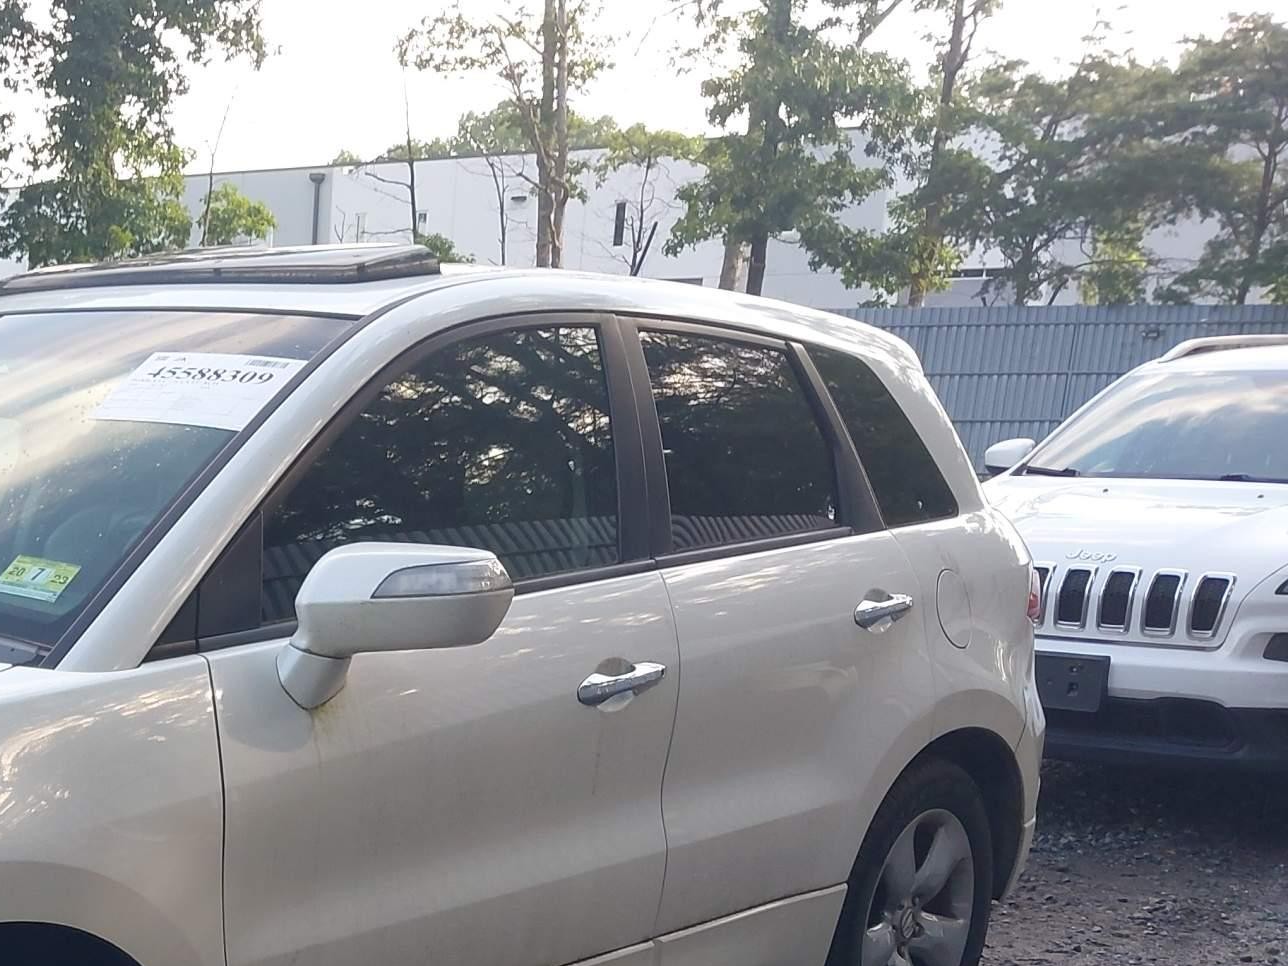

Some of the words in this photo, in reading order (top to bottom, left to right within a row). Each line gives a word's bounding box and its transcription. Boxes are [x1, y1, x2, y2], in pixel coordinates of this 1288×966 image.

[147, 366, 274, 385] 45588309
[1064, 549, 1118, 564] Jeep
[9, 567, 26, 577] 20
[50, 574, 69, 585] 23
